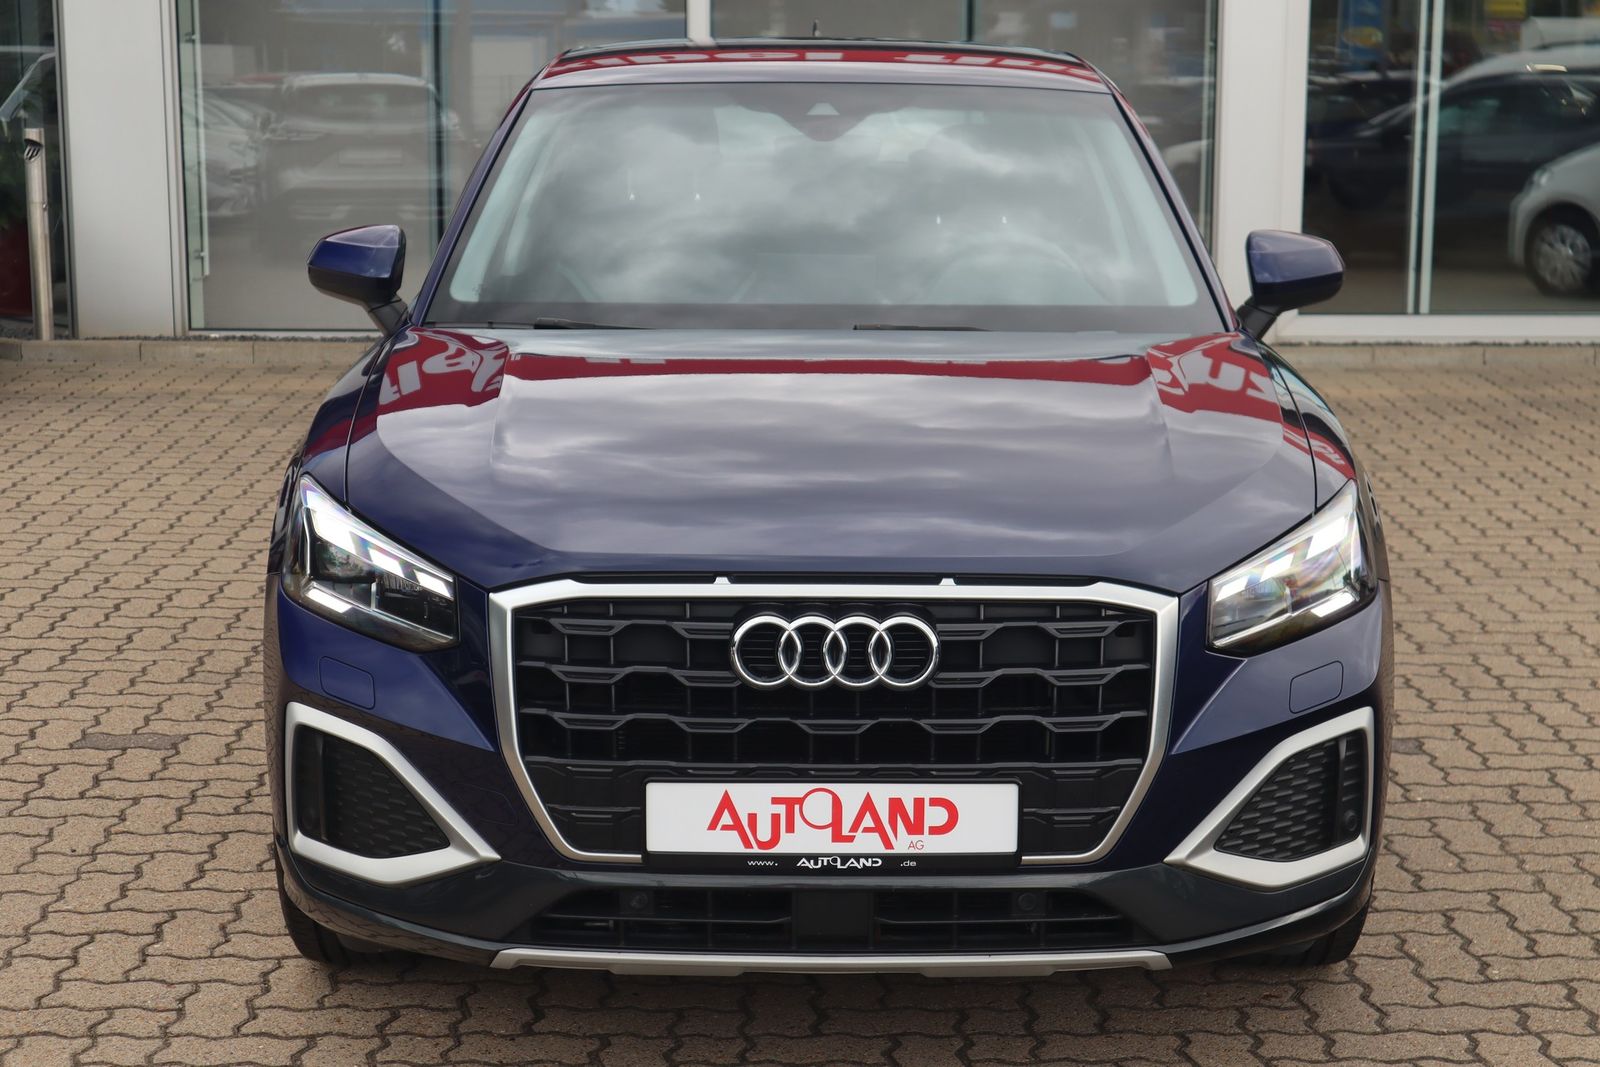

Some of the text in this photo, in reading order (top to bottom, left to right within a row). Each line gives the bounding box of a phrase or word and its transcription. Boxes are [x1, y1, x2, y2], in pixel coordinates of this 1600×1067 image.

[706, 787, 960, 850] AUTOLAND
[907, 840, 925, 850] AG
[796, 855, 883, 869] AUTOLAND
[900, 858, 917, 867] .de
